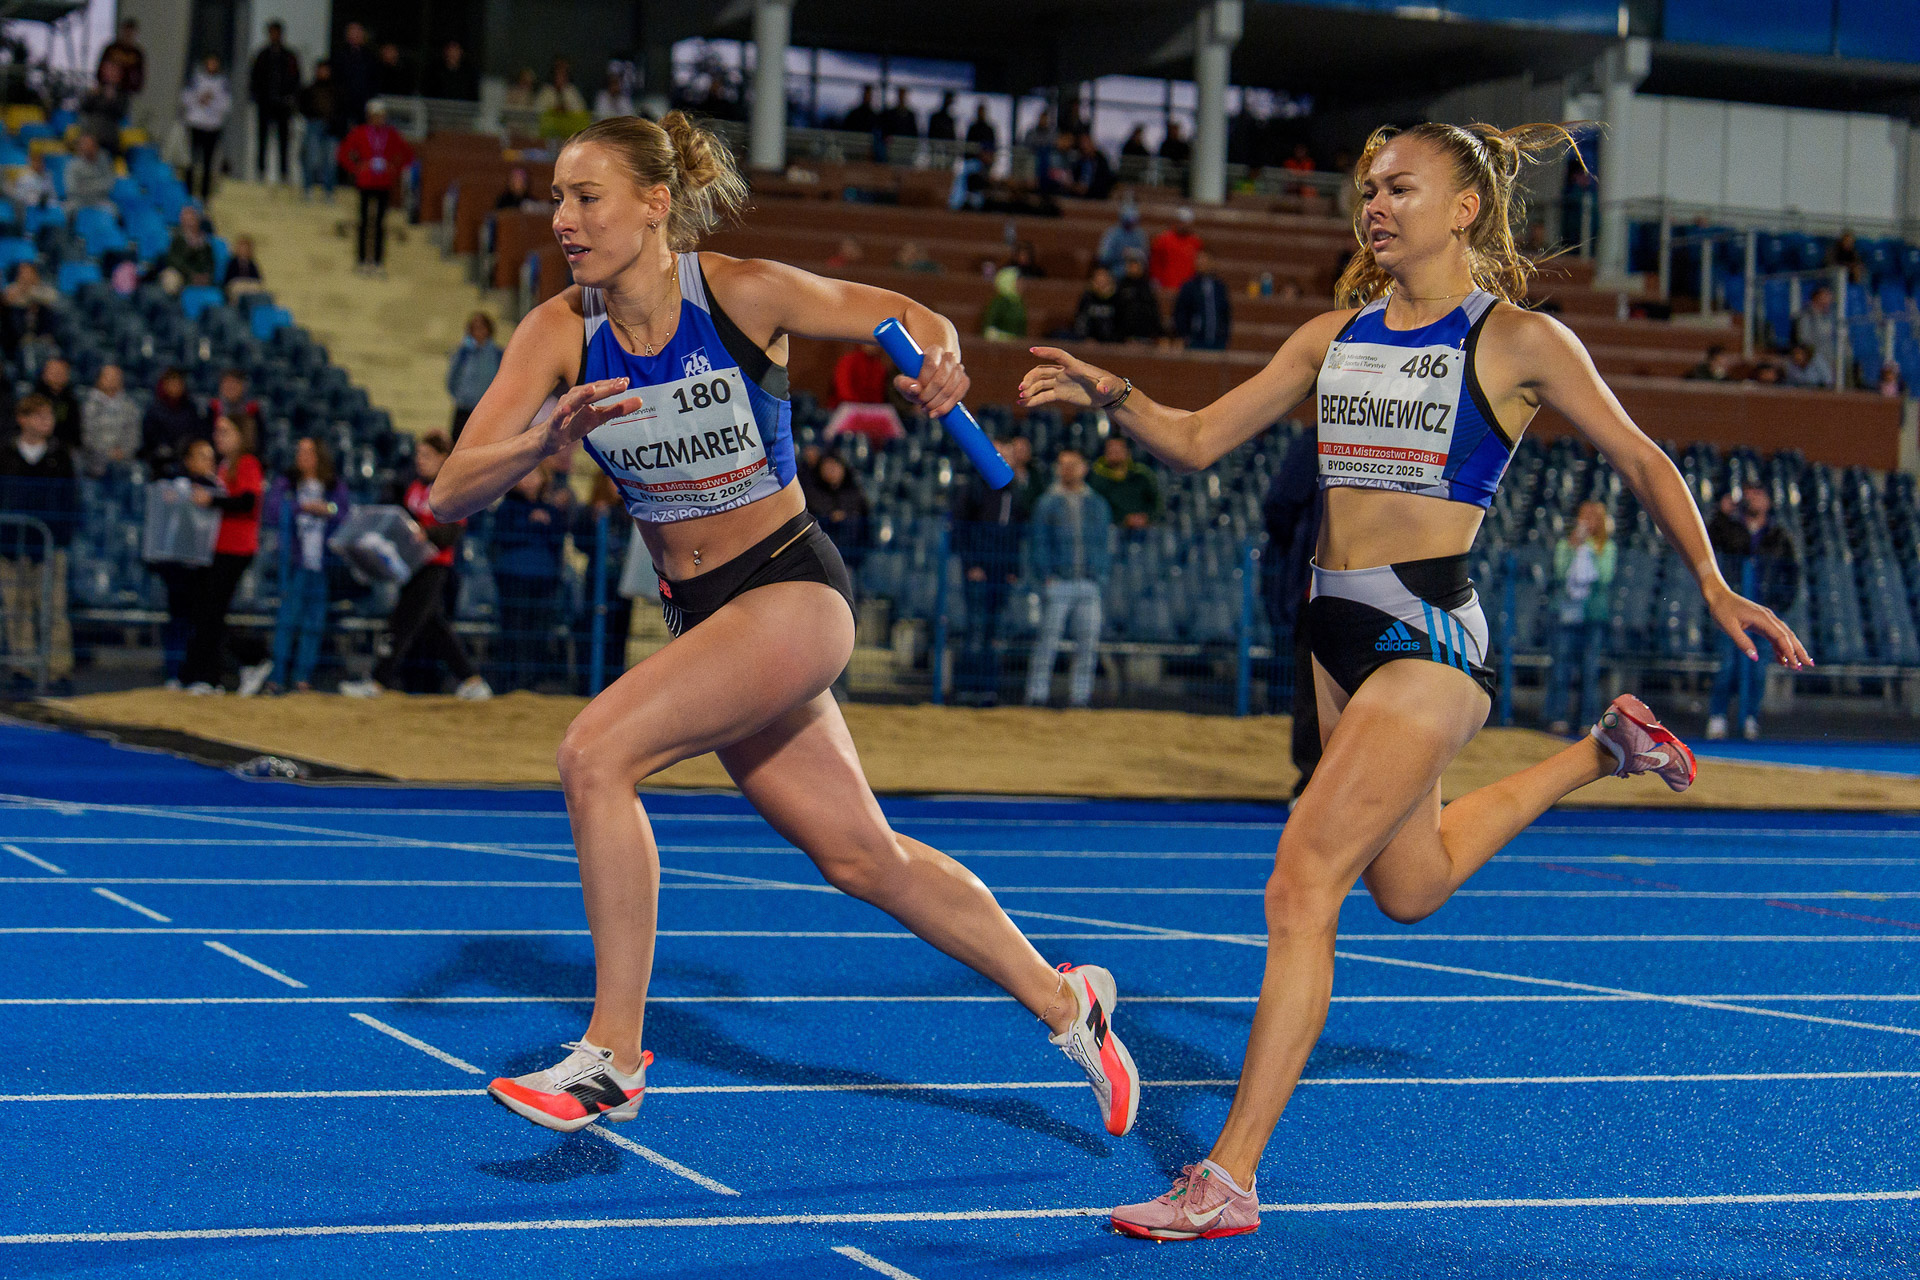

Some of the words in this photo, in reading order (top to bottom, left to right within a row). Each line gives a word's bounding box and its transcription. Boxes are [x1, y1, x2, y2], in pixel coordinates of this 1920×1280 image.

[1364, 361, 1387, 369] Turystyki
[1400, 353, 1449, 379] 486
[672, 378, 731, 414] 180
[1320, 390, 1452, 435] BEREŚNIEWICZ
[601, 422, 757, 471] KACZMAREK
[1322, 444, 1333, 454] 101.
[1333, 445, 1351, 456] PZLA
[1352, 446, 1406, 460] Mistrzostwa
[1407, 450, 1440, 464] Polski
[665, 477, 729, 491] Mistrzostwa
[729, 463, 760, 481] Polski
[1327, 460, 1395, 475] BYDGOSZCZ
[1395, 464, 1425, 478] 2025
[639, 492, 718, 503] BYDGOSZCZ
[719, 479, 752, 499] 2025
[650, 508, 677, 523] AZS
[1374, 639, 1421, 652] adidas
